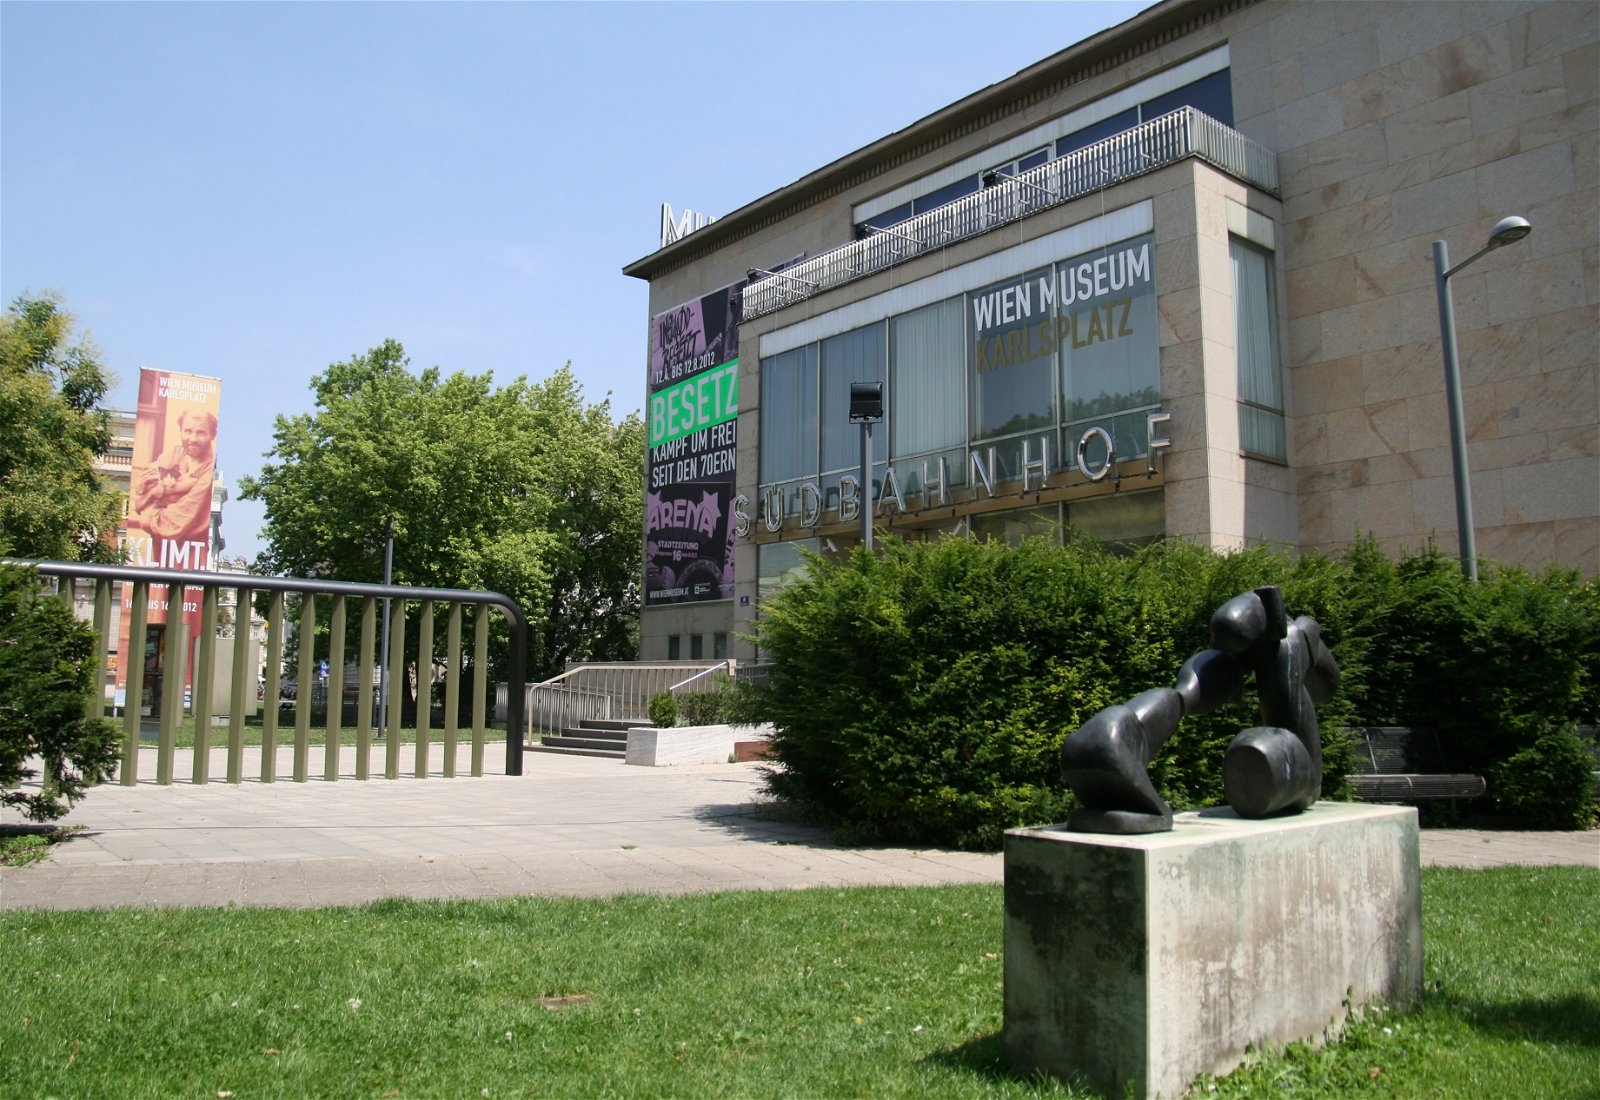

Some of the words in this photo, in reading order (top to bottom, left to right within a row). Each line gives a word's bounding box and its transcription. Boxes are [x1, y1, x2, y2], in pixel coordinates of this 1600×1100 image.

[974, 282, 1031, 332] WIEN
[1040, 243, 1150, 318] MUSEUM
[976, 296, 1134, 374] KARLSPLATZ
[160, 376, 181, 389] WIEN
[183, 380, 216, 394] MUSEUM
[671, 362, 683, 379] BIS
[684, 351, 715, 374] 12.8.2012
[158, 387, 208, 403] KARLSPLATZ
[653, 364, 738, 442] BESETZ
[653, 434, 688, 463] KAMPF
[691, 429, 708, 453] UM
[711, 420, 736, 448] FREI
[652, 463, 674, 488] SEIT
[676, 457, 697, 482] DEN
[701, 447, 736, 477] 70ERN
[733, 411, 1172, 537] SÜDBAHNHOF
[647, 498, 715, 539] ARENA
[657, 540, 699, 550] STADTZEITUNG
[673, 550, 682, 562] 16
[147, 600, 159, 610] IS
